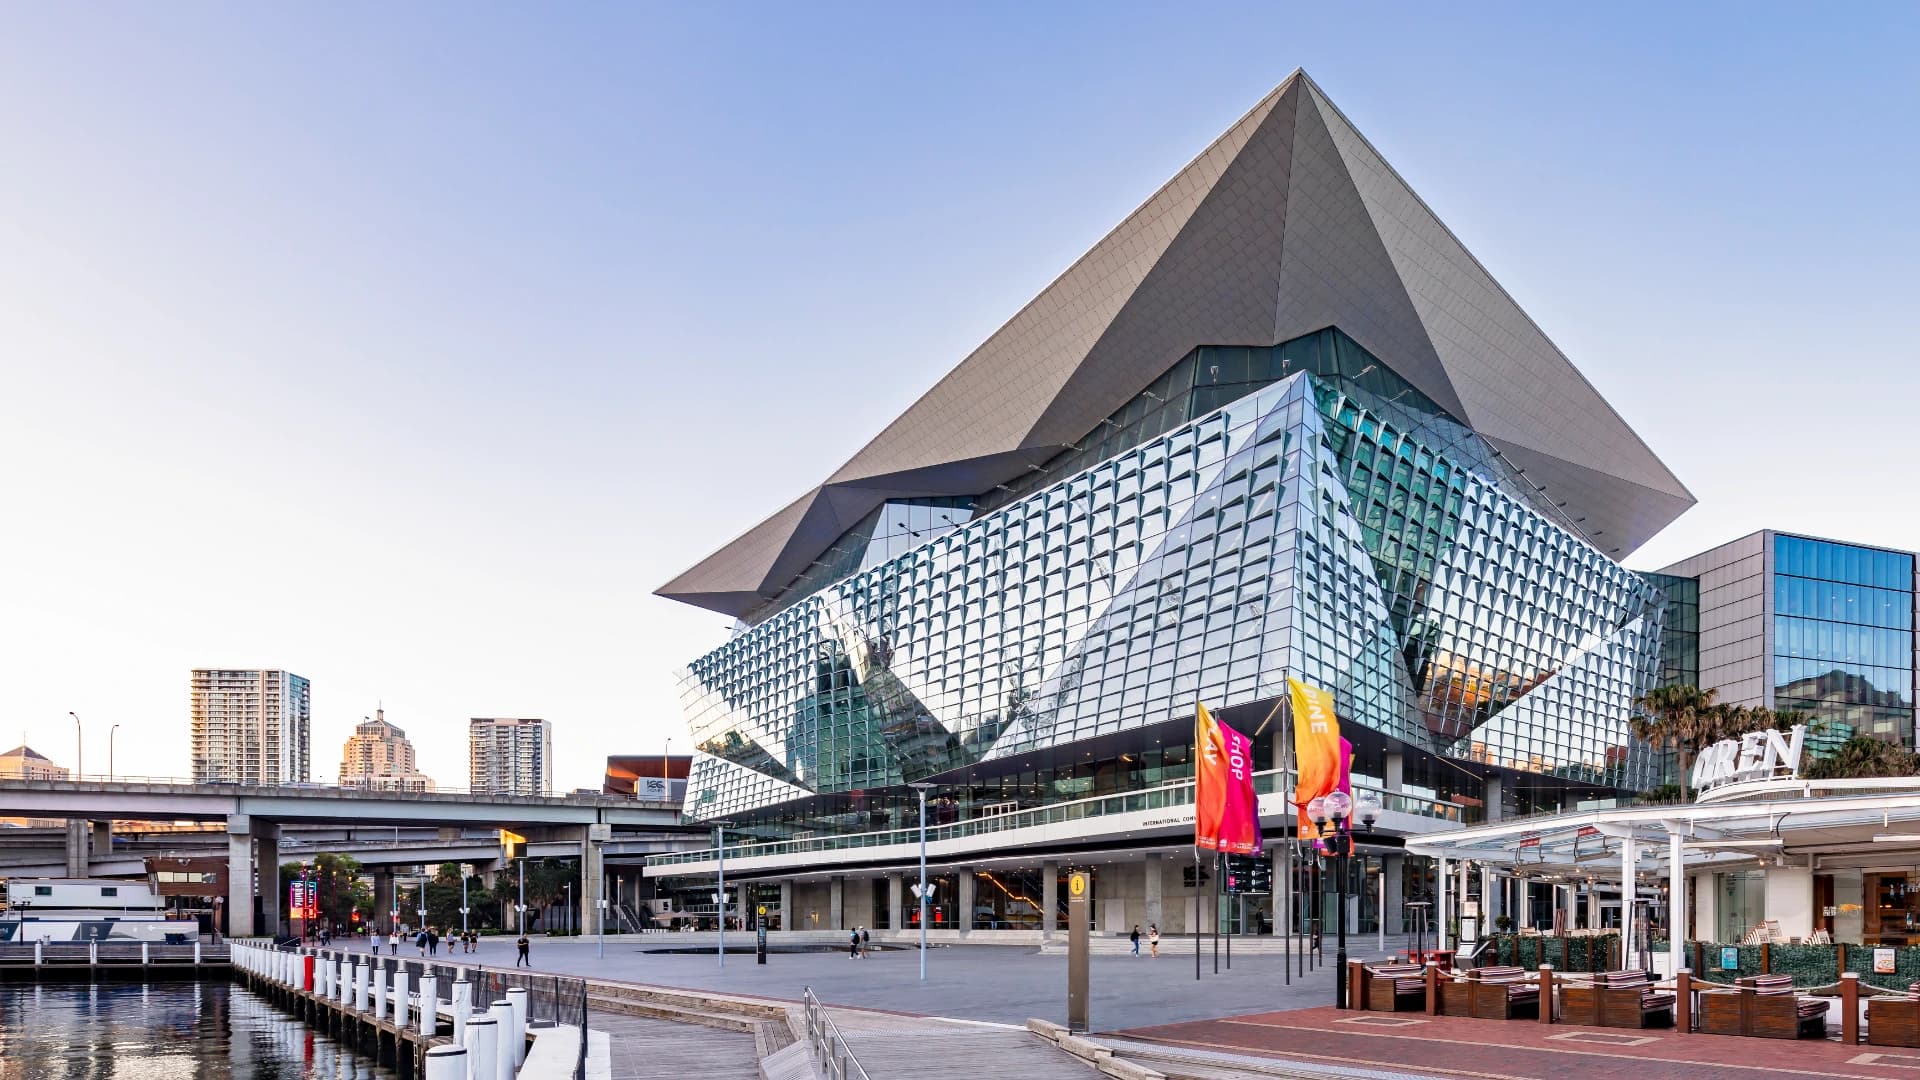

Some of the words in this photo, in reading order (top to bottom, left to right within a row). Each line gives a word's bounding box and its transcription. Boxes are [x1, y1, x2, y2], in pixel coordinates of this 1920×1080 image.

[1302, 687, 1329, 734] DINE
[1204, 722, 1219, 766] LAY
[1230, 732, 1244, 780] SHOP
[1142, 817, 1181, 827] INTERNATIONAL
